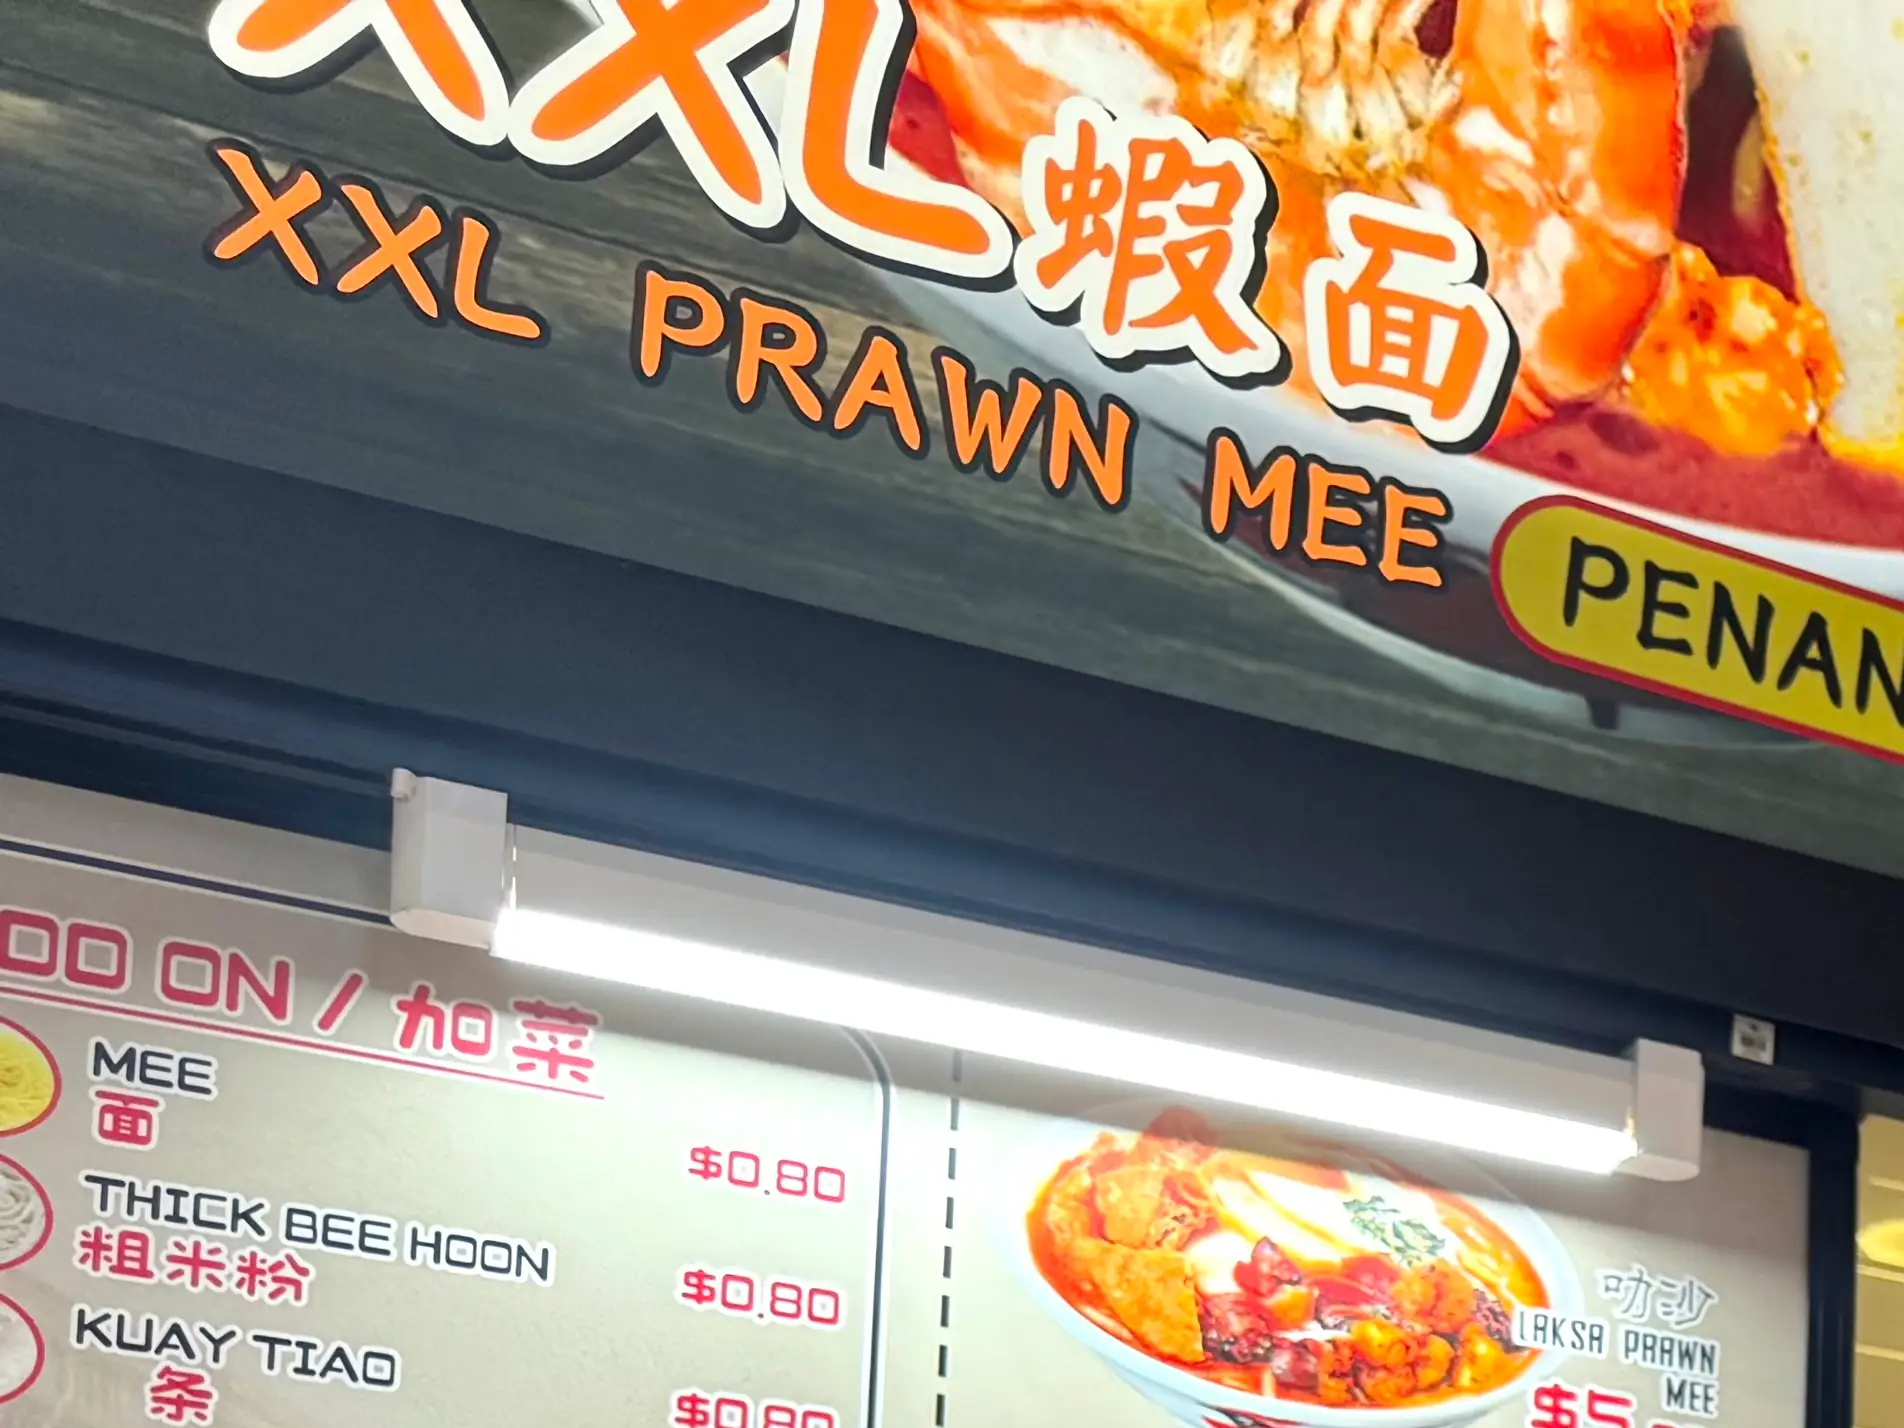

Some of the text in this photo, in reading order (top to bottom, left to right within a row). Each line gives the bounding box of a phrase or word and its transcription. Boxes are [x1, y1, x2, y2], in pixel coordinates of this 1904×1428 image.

[211, 148, 1447, 587] XXL PRAWN MEE
[160, 940, 291, 1022] ON
[398, 983, 600, 1086] 加菜
[91, 1040, 216, 1096] MEE
[97, 1093, 159, 1148] 面
[688, 1145, 847, 1205] $0.80
[84, 1173, 555, 1283] THICK BEE HOON
[78, 1225, 311, 1305] 粗米粉
[681, 1269, 842, 1328] $0.80
[1602, 1269, 1716, 1330] 叻沙
[75, 1307, 398, 1389] KUAY TIAO
[1516, 1308, 1719, 1377] LAKSA PRAWN
[150, 1366, 216, 1425] 条
[1664, 1375, 1719, 1416] MEE
